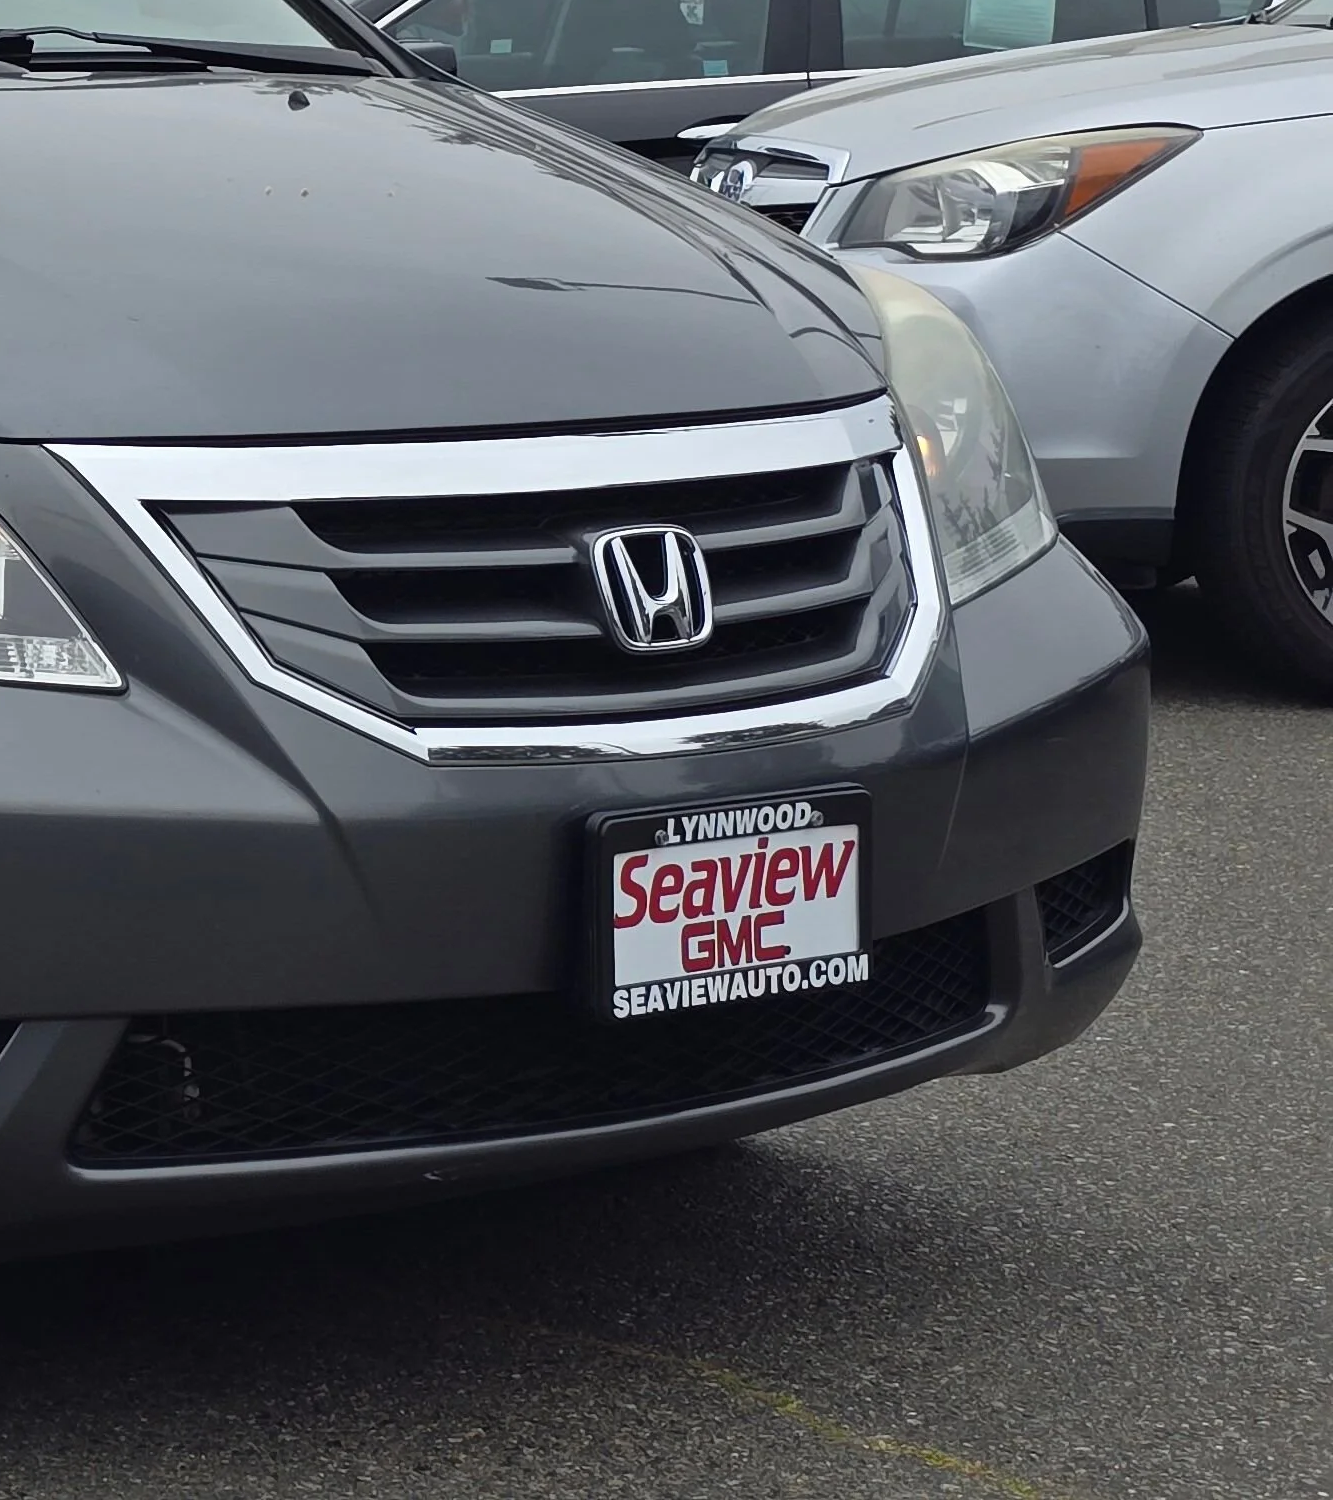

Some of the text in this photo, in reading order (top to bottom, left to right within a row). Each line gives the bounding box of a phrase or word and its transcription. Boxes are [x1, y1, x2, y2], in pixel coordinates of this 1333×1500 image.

[666, 802, 812, 844] LYNNWOOD
[613, 837, 855, 929] Seaview
[681, 911, 789, 973] GMC
[613, 954, 869, 1019] SEAVIEWAUTO.COM
